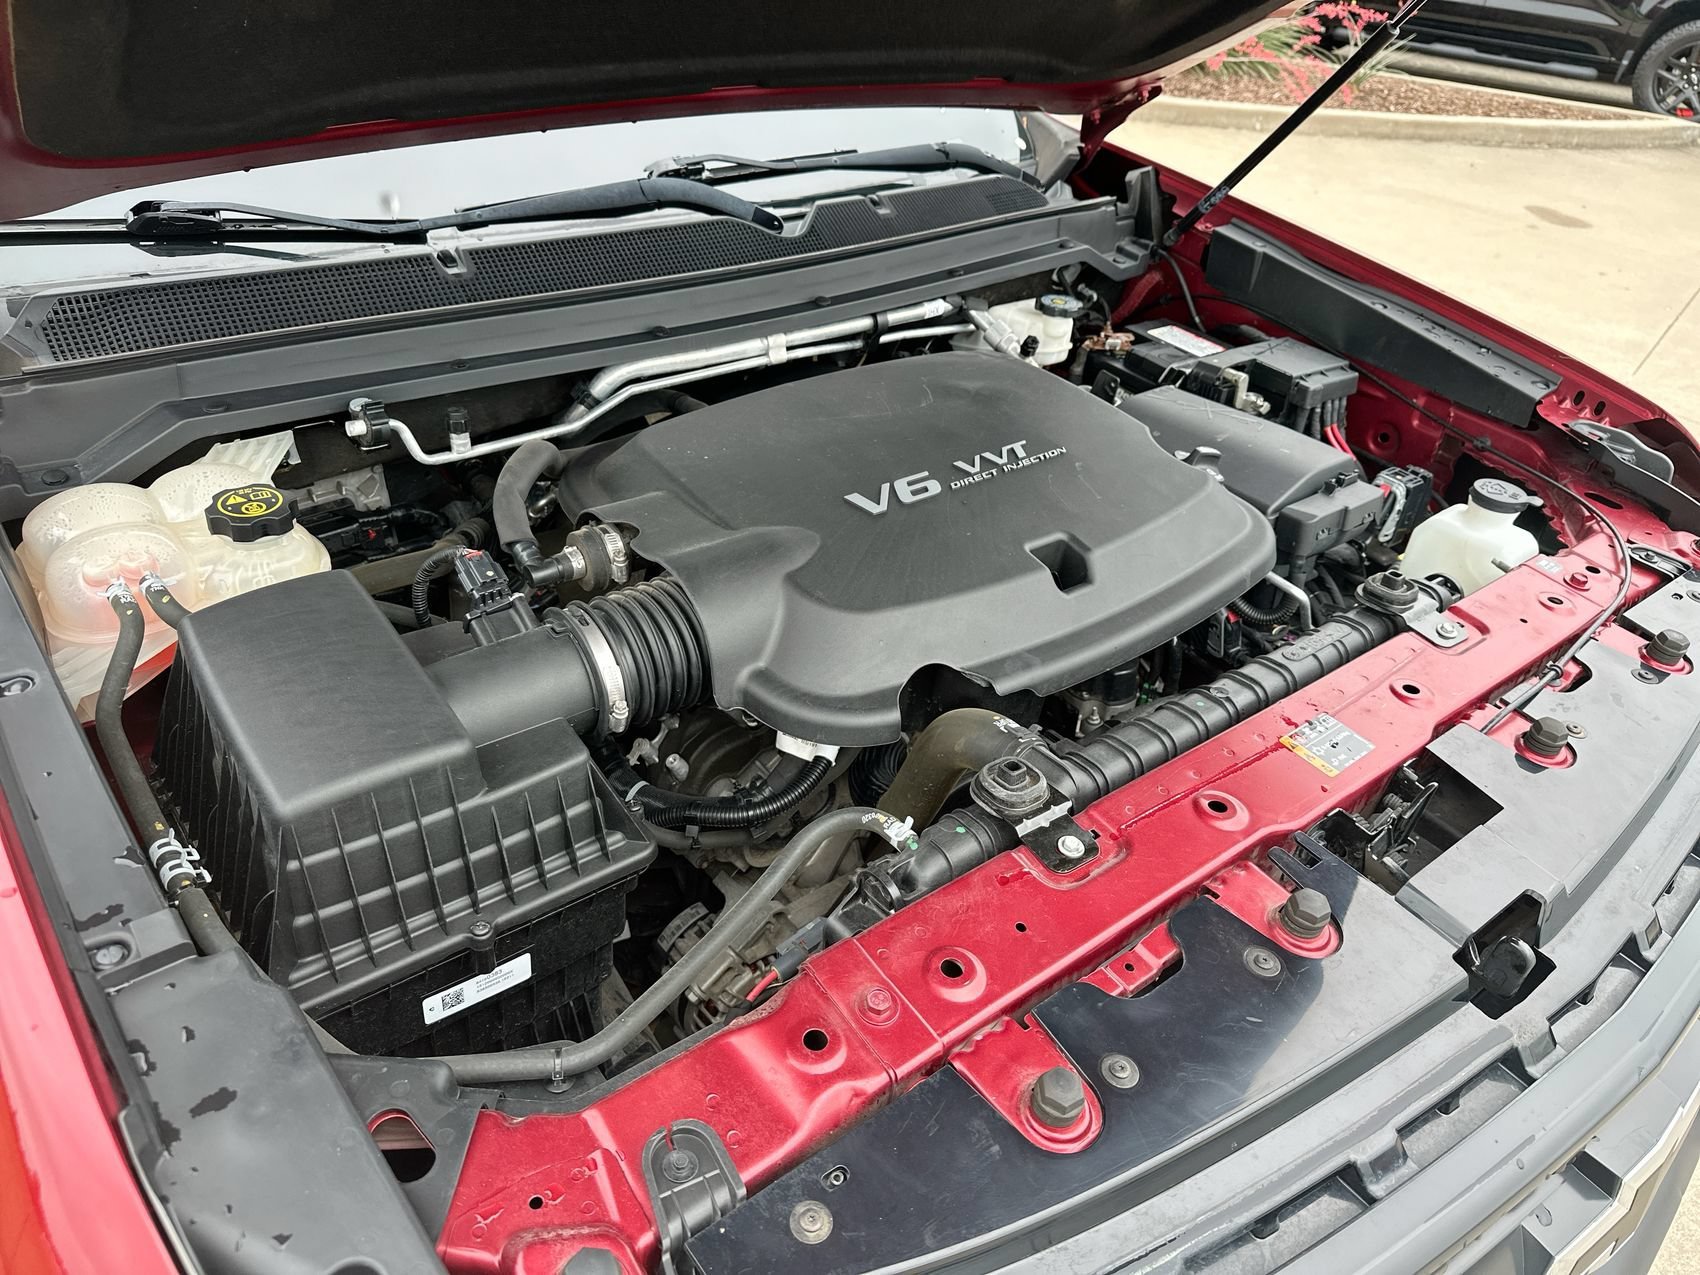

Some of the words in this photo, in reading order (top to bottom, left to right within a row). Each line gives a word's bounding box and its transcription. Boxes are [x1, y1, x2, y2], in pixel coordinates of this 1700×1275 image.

[950, 468, 998, 490] DIRECT
[1001, 446, 1067, 472] INJECTION
[953, 440, 1026, 473] VVT
[844, 471, 942, 515] V6
